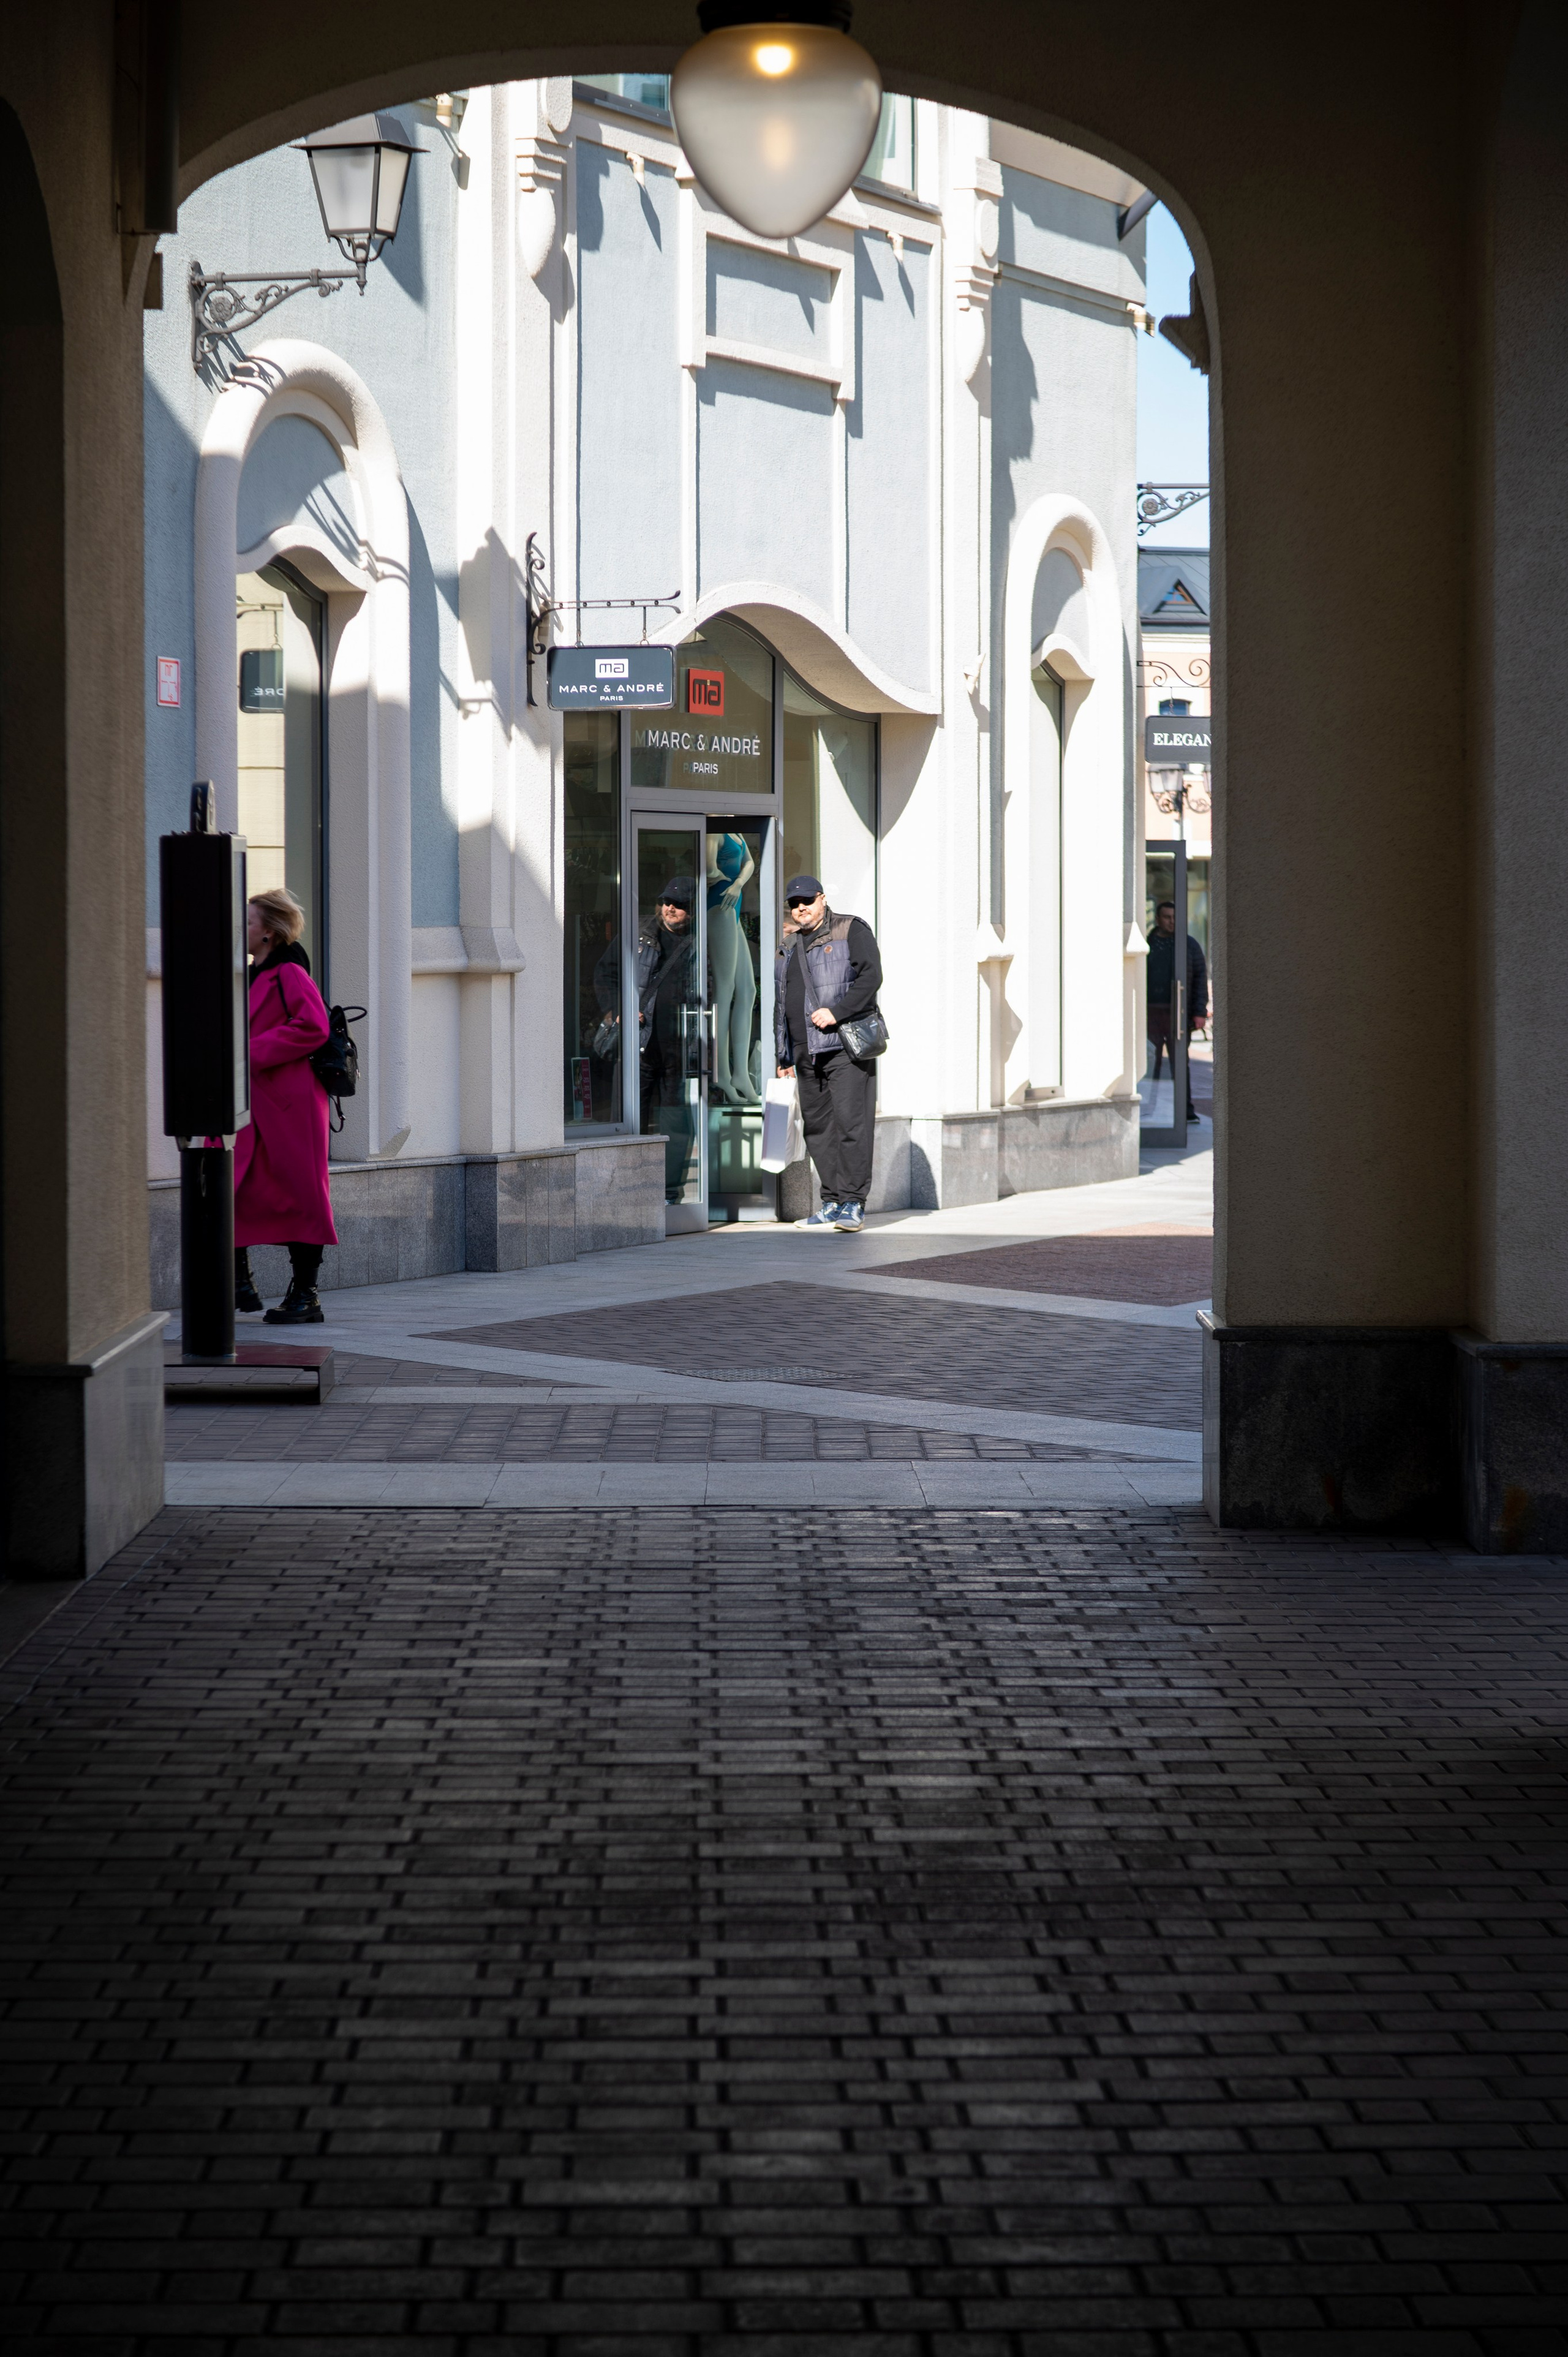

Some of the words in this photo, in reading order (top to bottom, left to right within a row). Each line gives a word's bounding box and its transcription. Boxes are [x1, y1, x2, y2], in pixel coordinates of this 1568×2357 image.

[559, 684, 597, 693] MARC
[603, 684, 611, 693] &
[617, 682, 665, 693] ANDRÉ
[648, 730, 691, 750] MARC
[697, 733, 706, 751] &
[711, 735, 761, 756] ANDRÉ
[693, 761, 719, 774] PARIS
